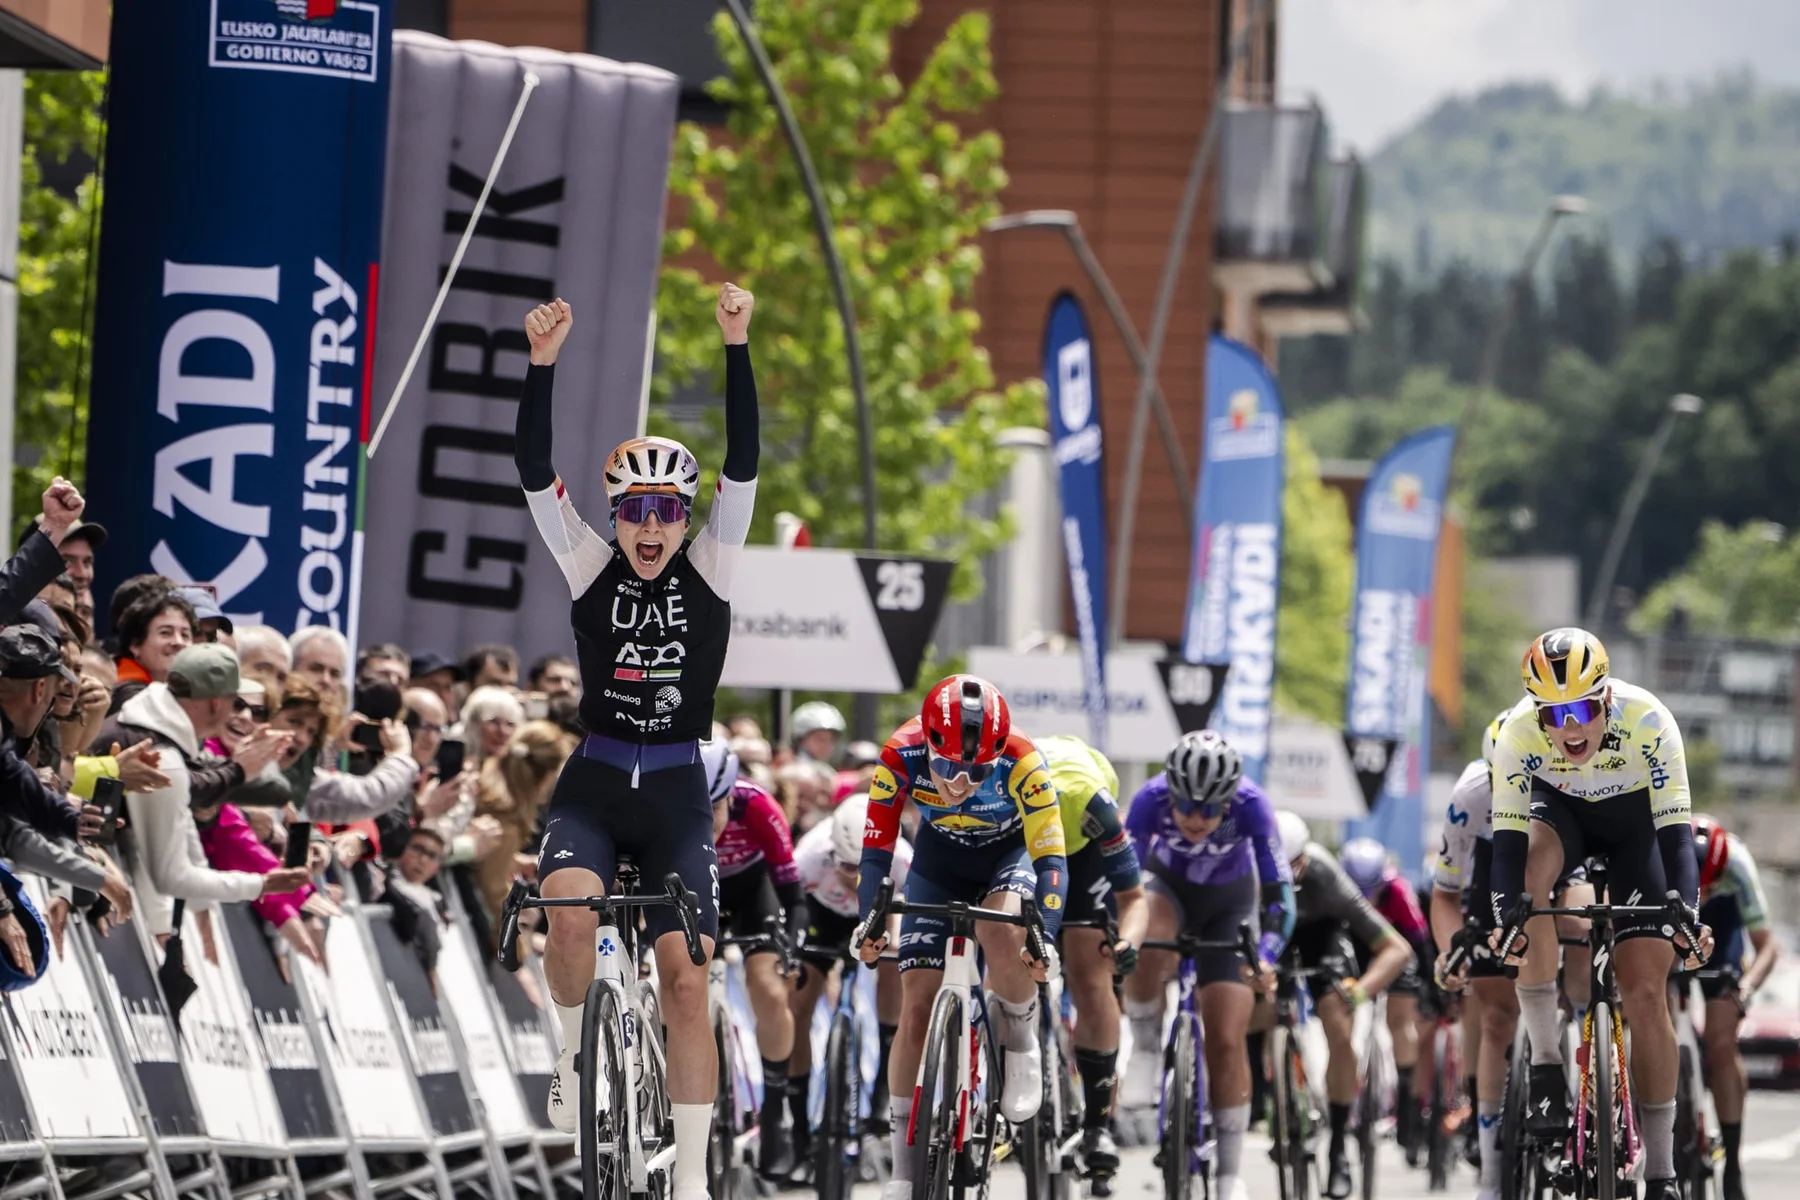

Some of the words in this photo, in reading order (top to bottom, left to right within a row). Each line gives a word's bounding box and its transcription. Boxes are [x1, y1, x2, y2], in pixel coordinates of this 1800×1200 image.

[221, 20, 277, 38] EUSKO
[281, 25, 372, 49] JAURLARITZA
[226, 44, 320, 65] GOBIERNO
[323, 51, 368, 71] VASCO
[407, 162, 566, 612] GOBIK
[876, 562, 925, 611] 25
[611, 595, 687, 630] UAE
[612, 625, 688, 637] TEAM
[611, 691, 641, 706] Analog
[655, 700, 669, 709] IHC
[941, 685, 951, 727] TREK
[640, 723, 672, 732] GROUP
[900, 932, 939, 948] EK
